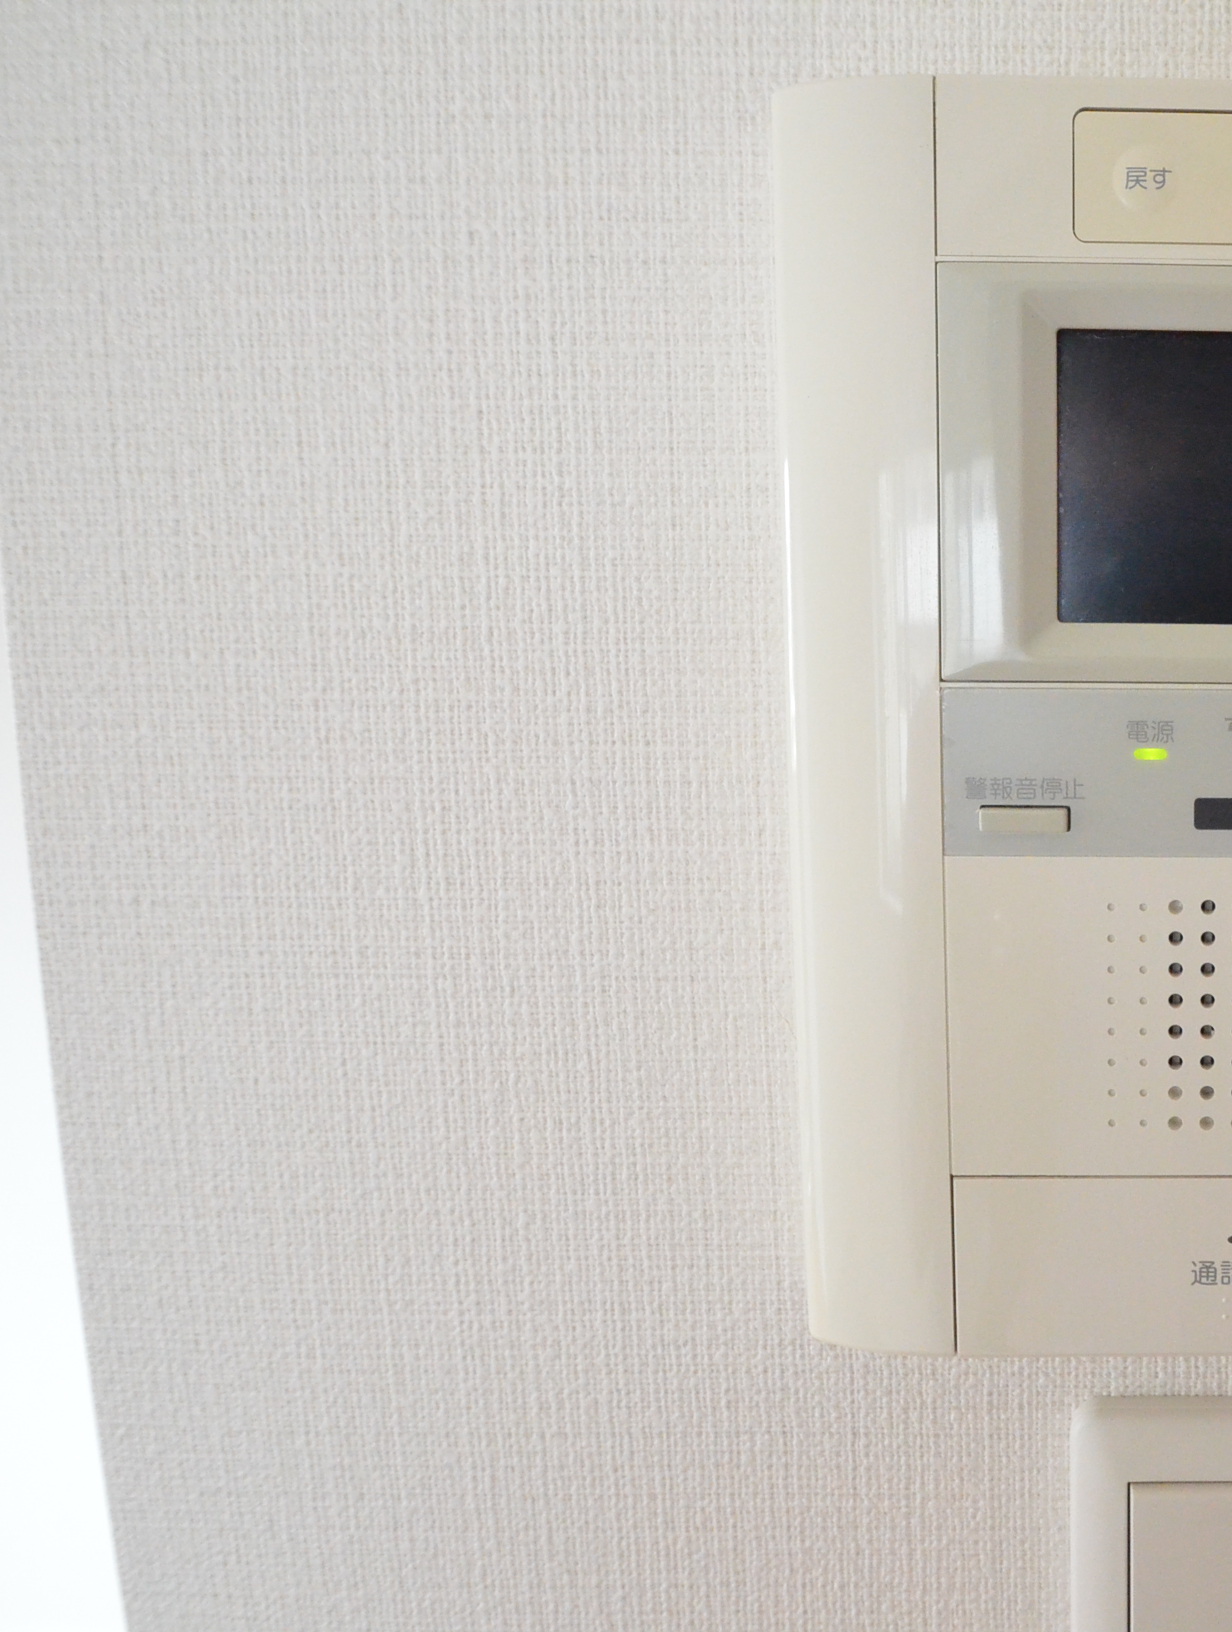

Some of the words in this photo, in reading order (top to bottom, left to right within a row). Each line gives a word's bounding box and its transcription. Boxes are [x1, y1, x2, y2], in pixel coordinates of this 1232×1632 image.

[1124, 166, 1172, 190] 戻す
[1126, 720, 1175, 743] 電源
[964, 777, 1086, 800] 警報音停止
